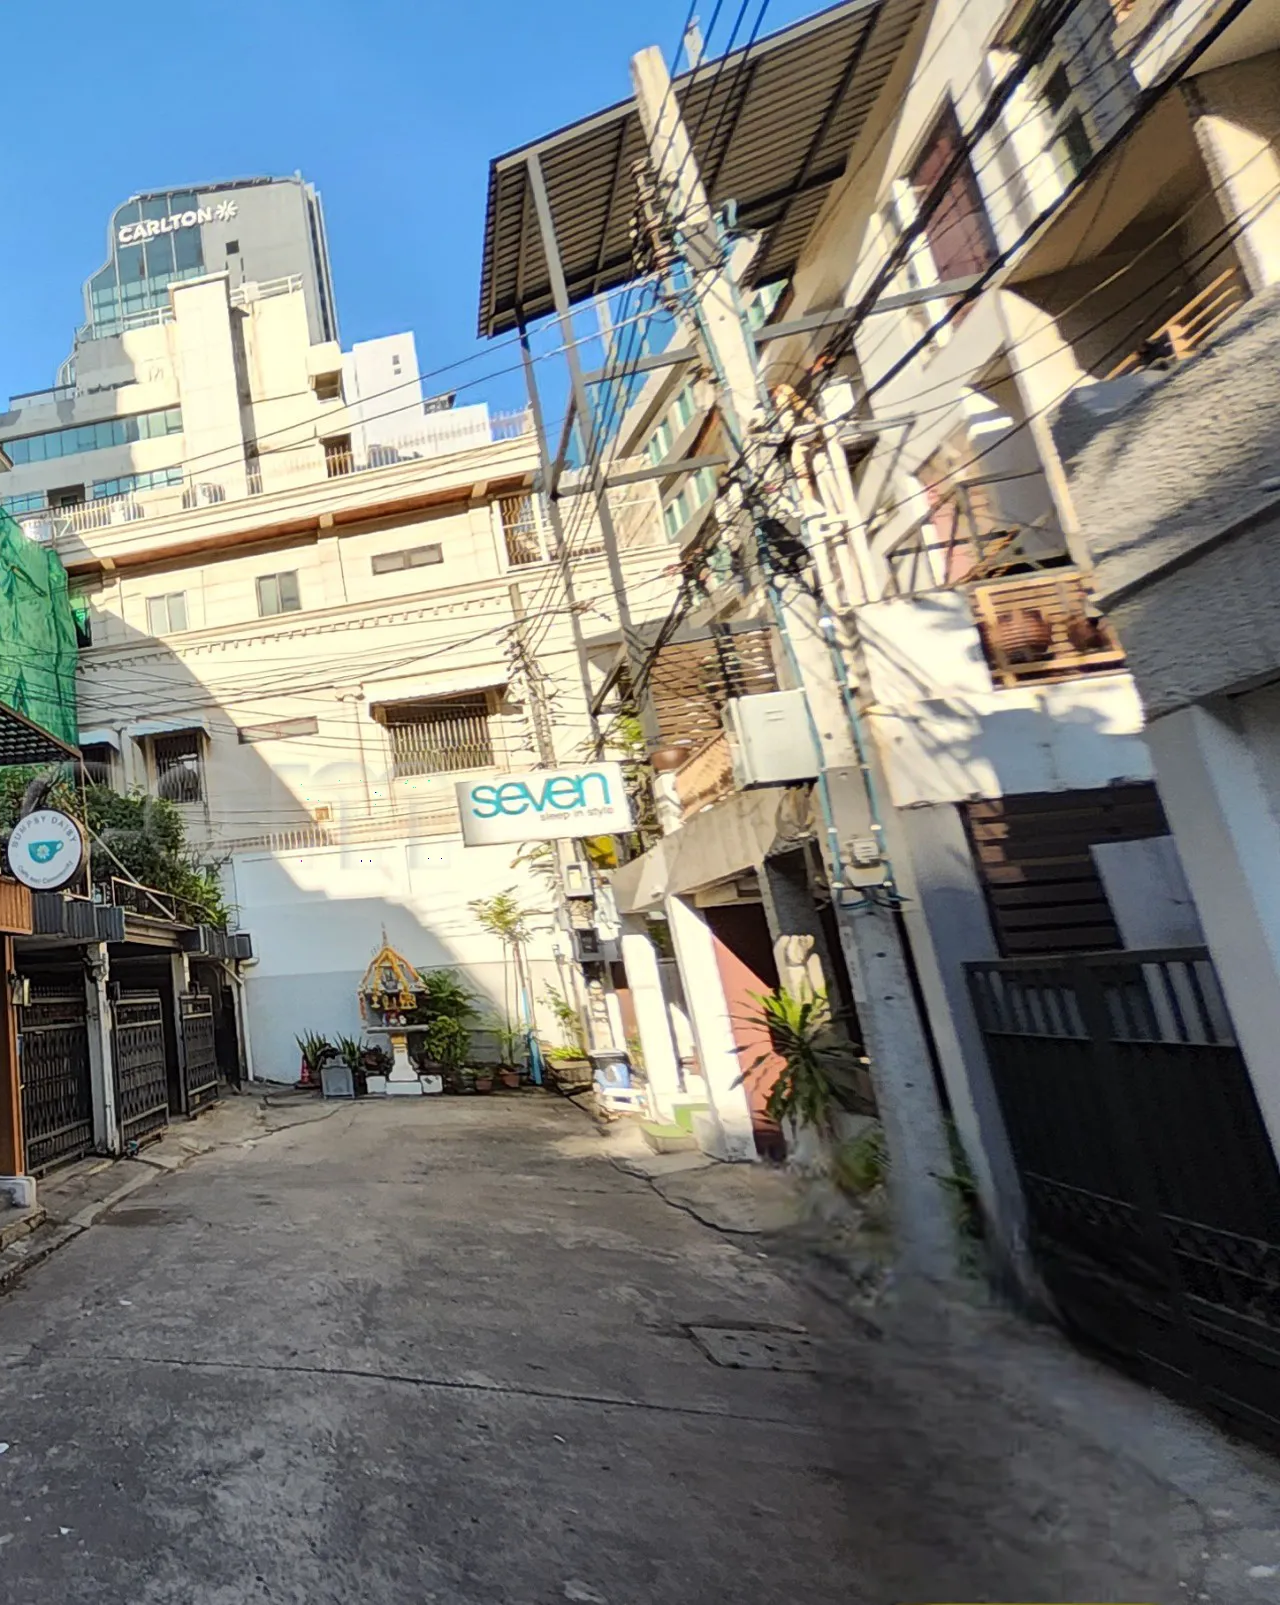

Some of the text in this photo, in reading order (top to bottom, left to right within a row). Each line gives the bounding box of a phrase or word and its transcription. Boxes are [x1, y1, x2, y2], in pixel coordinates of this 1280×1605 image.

[118, 206, 213, 243] CARLTON
[471, 772, 611, 818] seven
[574, 810, 584, 818] in
[587, 806, 615, 818] style
